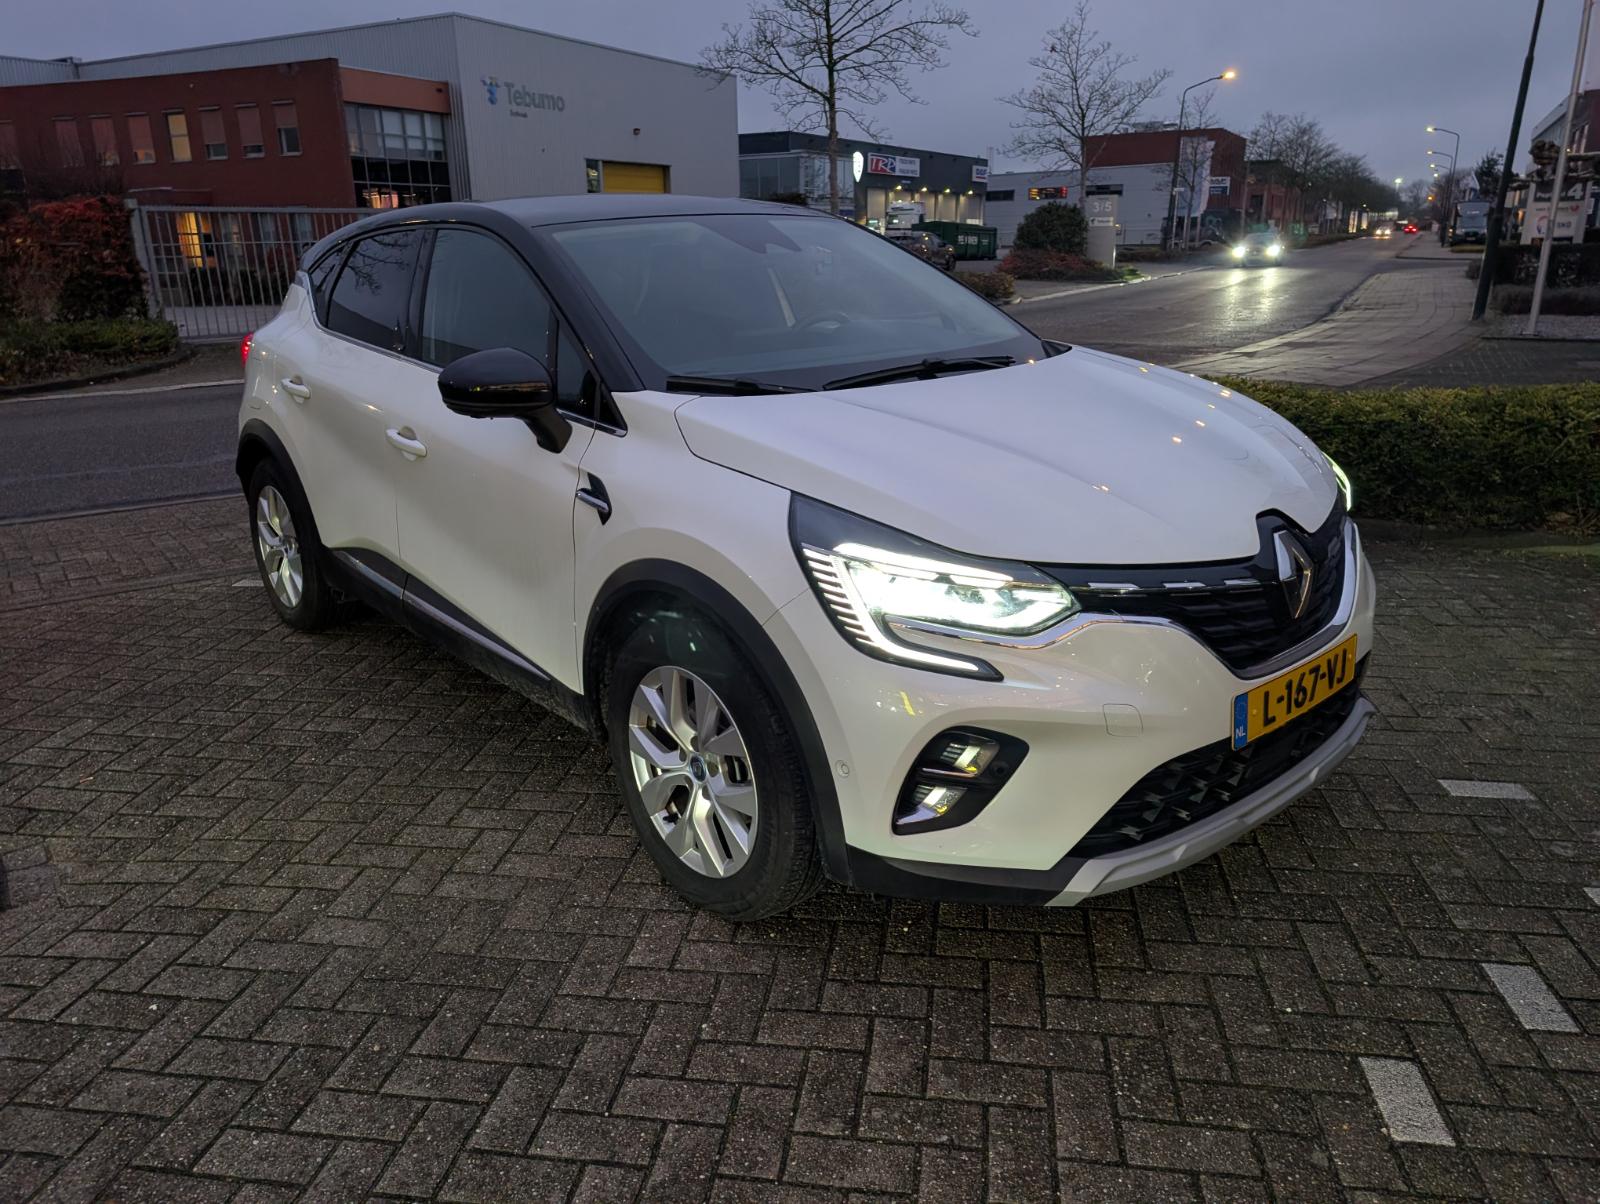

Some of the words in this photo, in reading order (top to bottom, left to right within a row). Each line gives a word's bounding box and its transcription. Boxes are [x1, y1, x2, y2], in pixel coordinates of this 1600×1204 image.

[503, 81, 565, 112] Tebumo
[871, 157, 896, 172] TRP
[1567, 183, 1584, 200] 4
[1093, 201, 1112, 212] 3/5
[1235, 725, 1246, 738] NL
[1263, 648, 1348, 727] L-167-VJ
